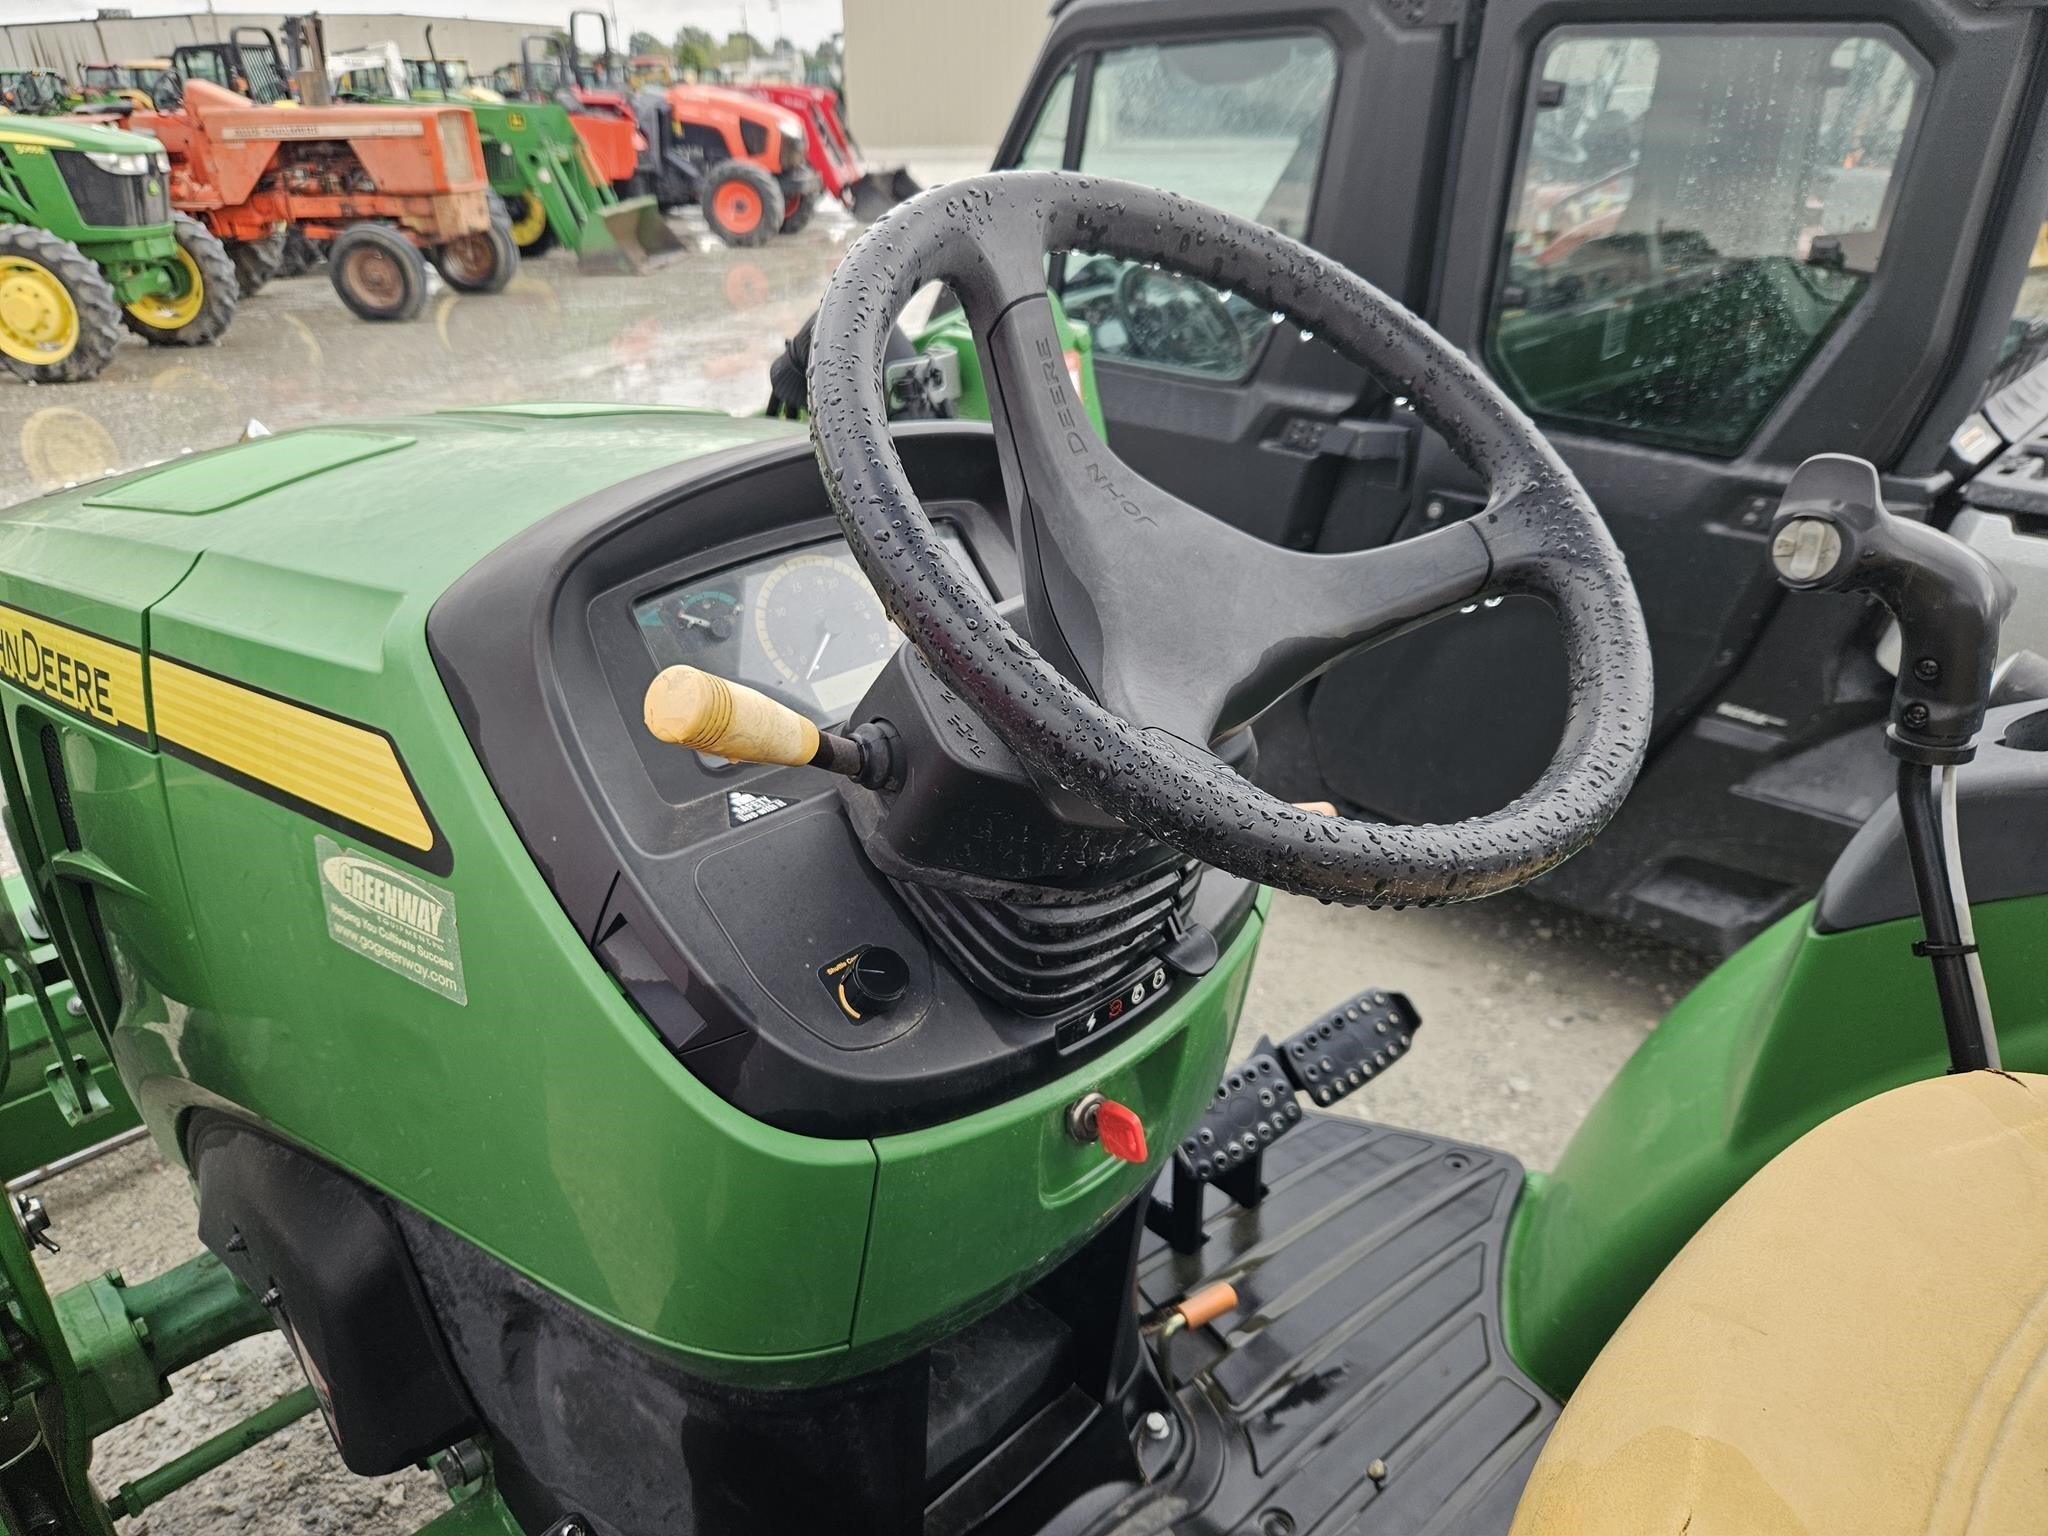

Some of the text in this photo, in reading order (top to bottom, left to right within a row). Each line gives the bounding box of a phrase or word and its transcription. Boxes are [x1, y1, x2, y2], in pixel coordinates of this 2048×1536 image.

[1035, 336, 1159, 528] JOHN DEERE
[22, 629, 114, 716] DEERE
[970, 745, 986, 758] R
[340, 862, 443, 936] GREENWAY
[334, 923, 457, 992] www.gogreenway.com
[417, 944, 454, 971] Success
